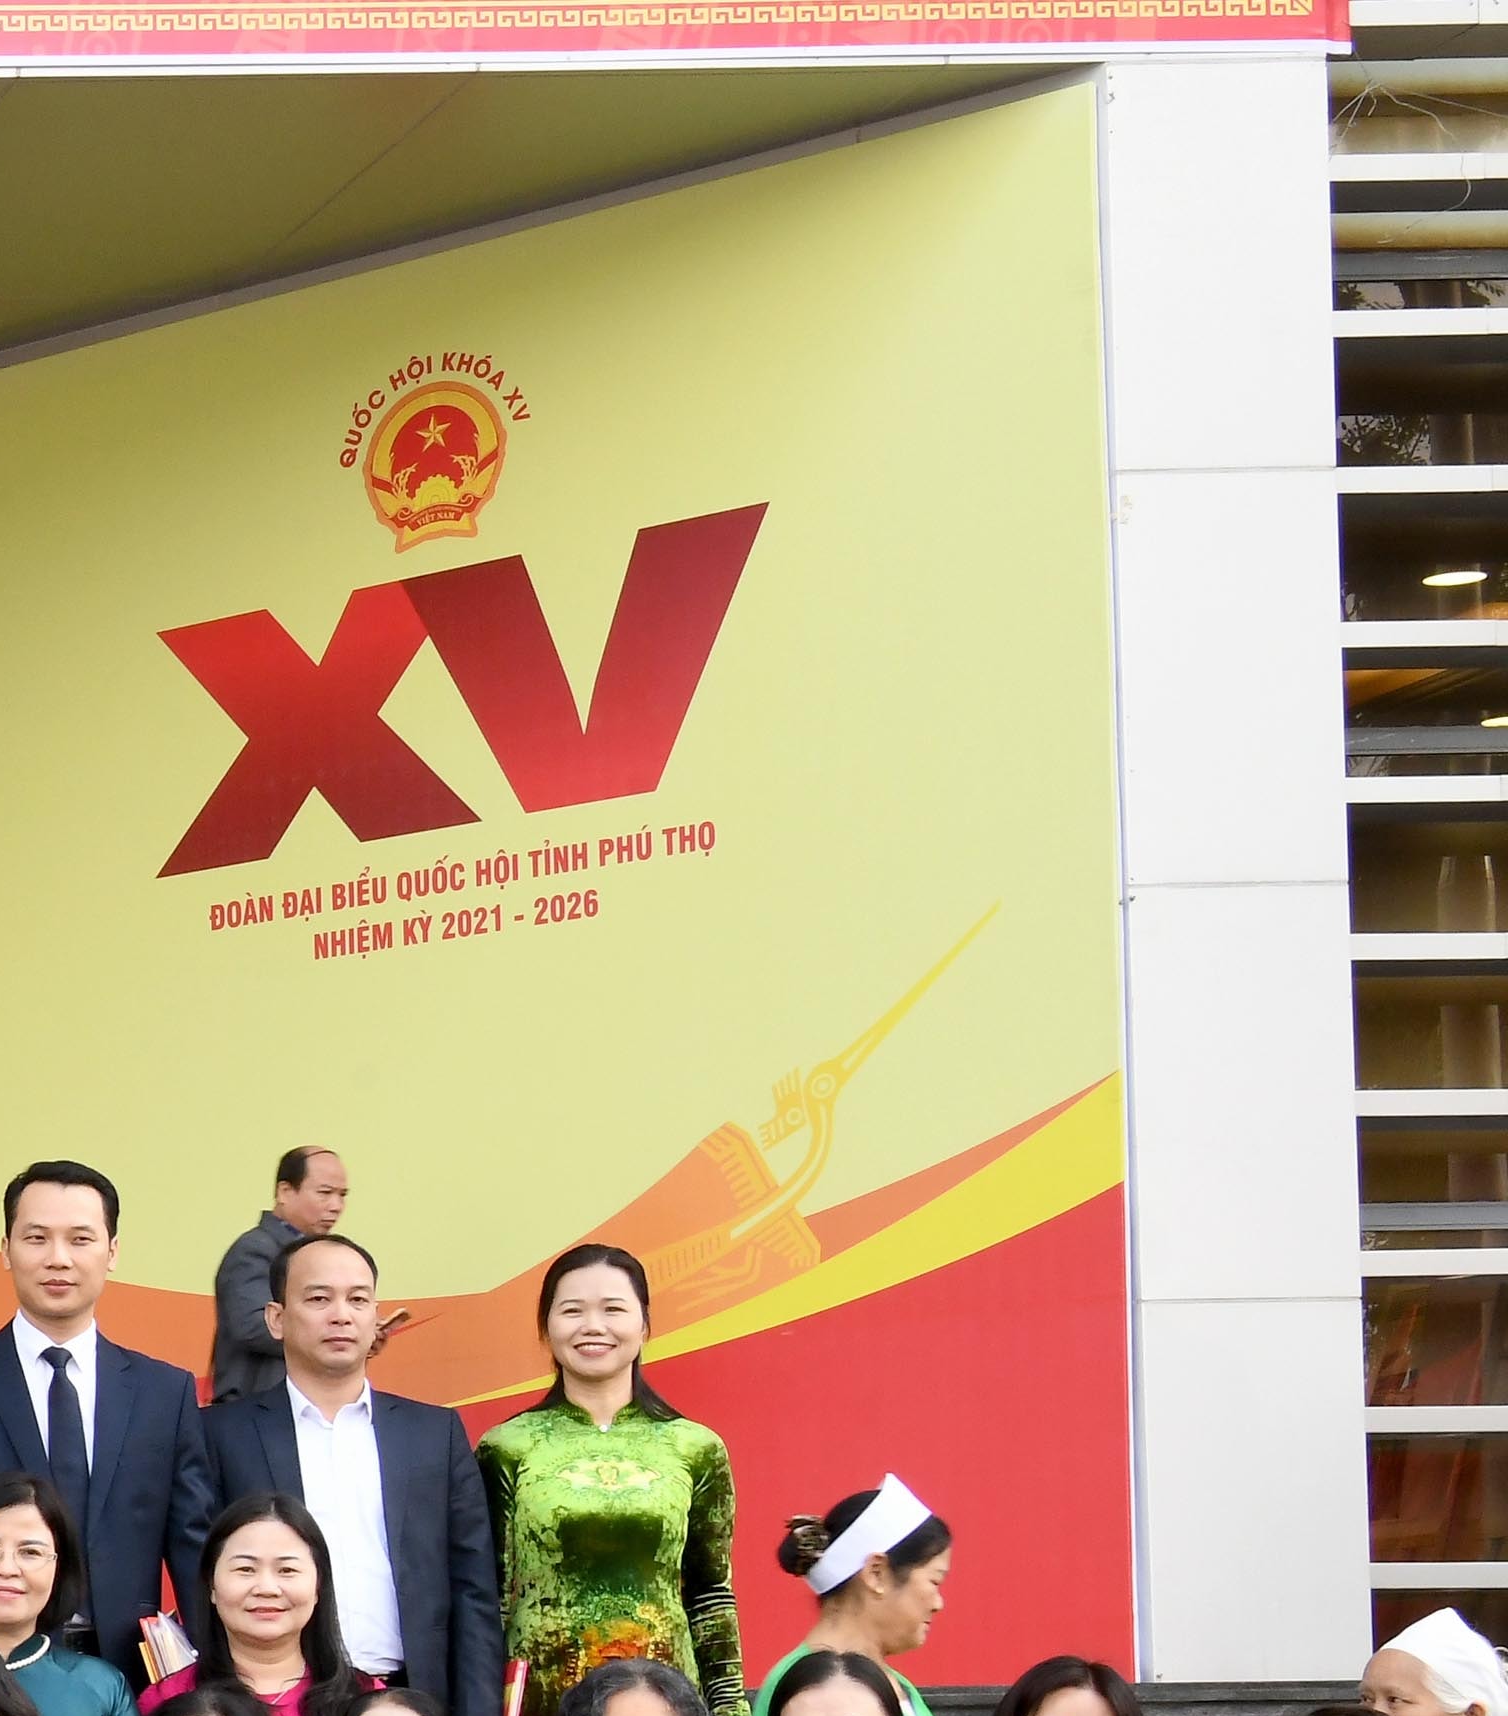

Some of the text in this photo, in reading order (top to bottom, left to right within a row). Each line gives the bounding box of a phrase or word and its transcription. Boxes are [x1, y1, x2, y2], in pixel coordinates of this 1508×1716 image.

[339, 352, 531, 468] QUỐC HỘI KHÓA XV
[208, 819, 717, 933] ĐOÀN ĐẠI BIỂU QUỐC HỘI TỈNH PHÚ THỌ
[312, 888, 601, 961] NHIỆM KỲ 2021 - 2026
